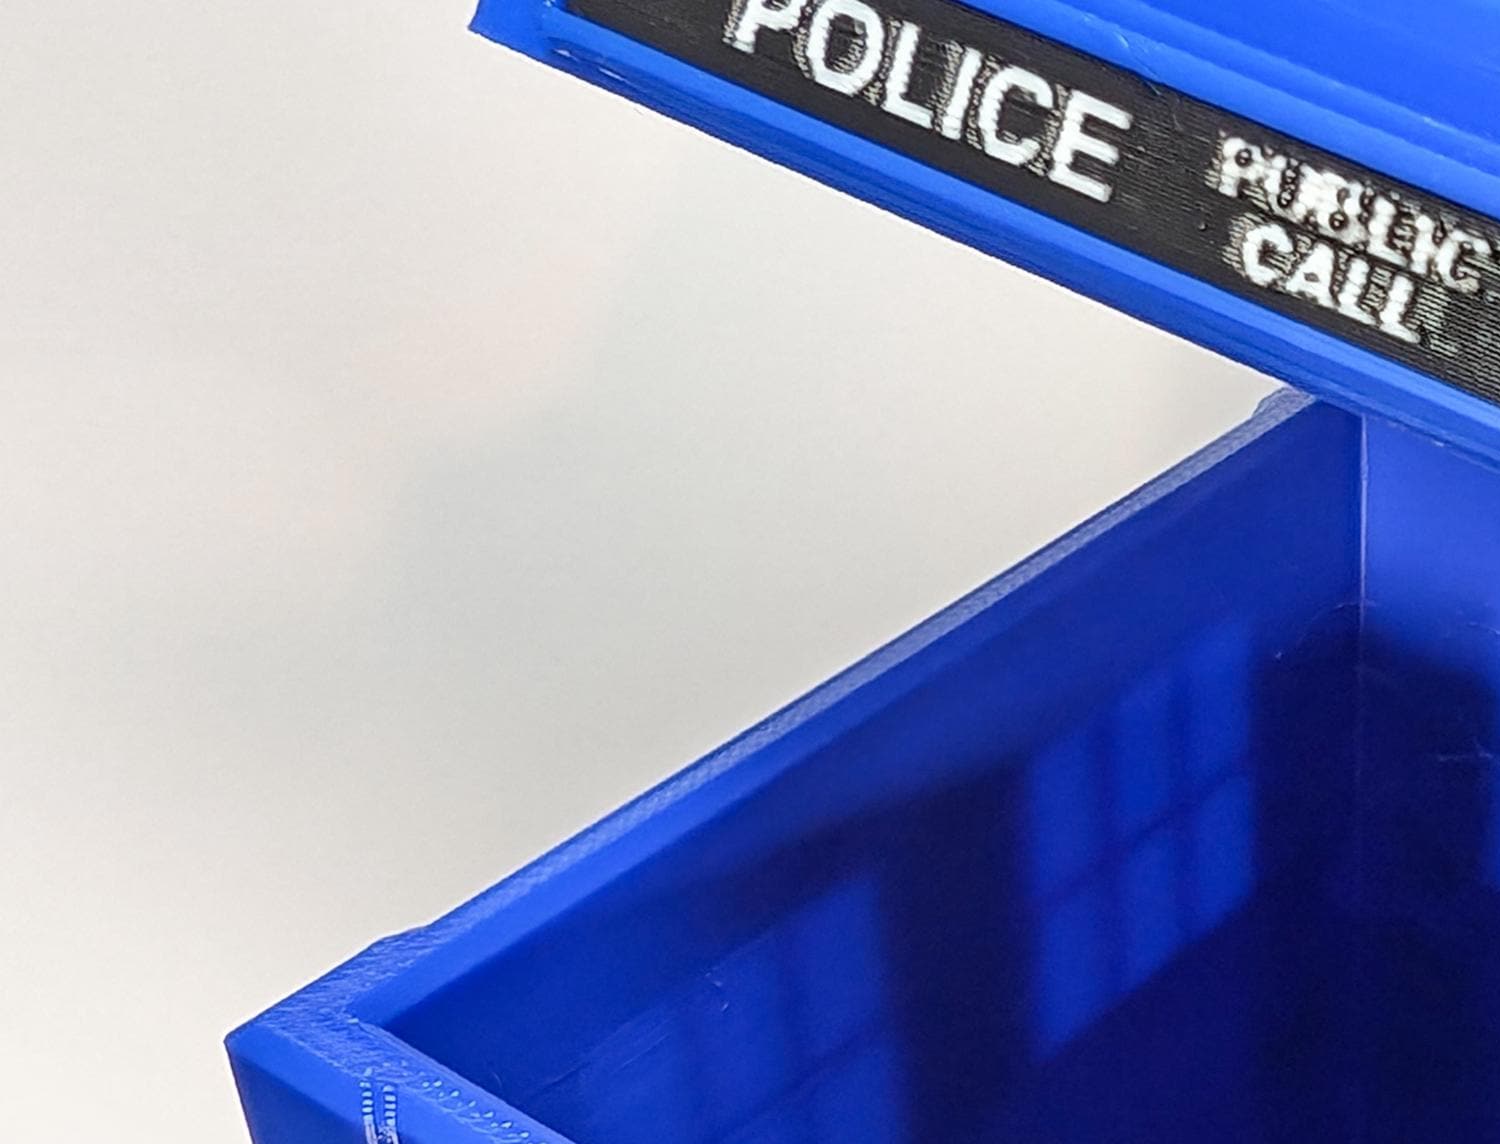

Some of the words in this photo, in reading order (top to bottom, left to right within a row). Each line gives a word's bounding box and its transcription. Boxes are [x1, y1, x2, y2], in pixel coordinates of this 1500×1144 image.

[735, 0, 1133, 204] POLICE
[1217, 137, 1493, 294] PUBLIC
[1239, 222, 1421, 344] CALL
